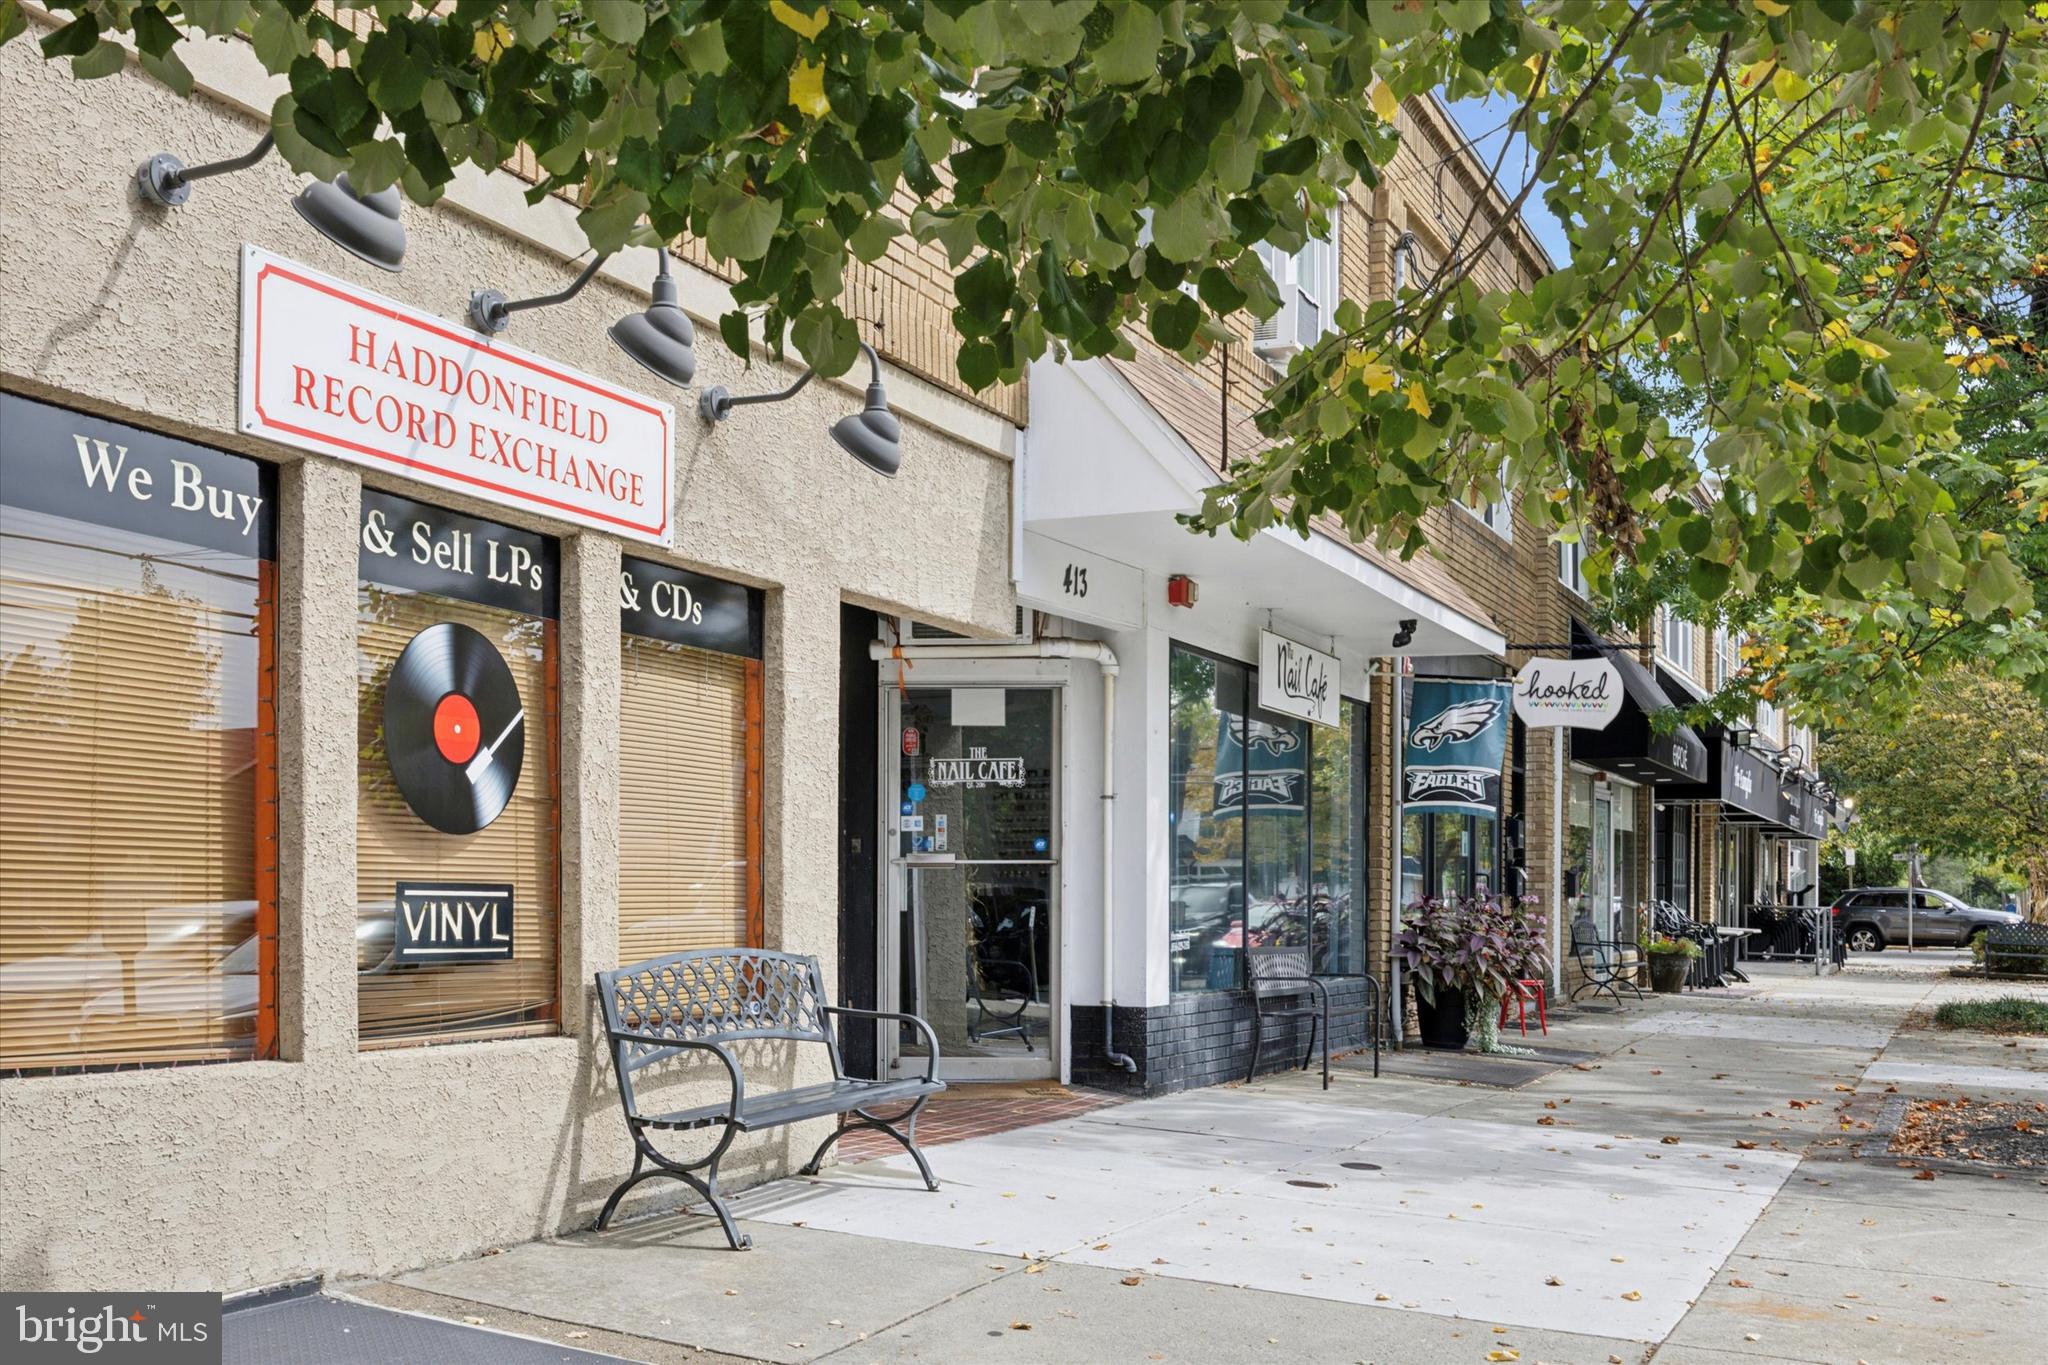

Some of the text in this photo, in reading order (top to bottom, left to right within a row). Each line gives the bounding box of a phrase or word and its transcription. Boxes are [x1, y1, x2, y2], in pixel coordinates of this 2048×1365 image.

[348, 322, 608, 445] HADDONFIELD
[292, 364, 646, 508] RECORD EXCHANGE
[73, 434, 263, 536] We Buy
[363, 509, 542, 590] & Sell LPs
[620, 571, 702, 625] & CDs
[1063, 563, 1088, 598] 413
[1278, 643, 1304, 699] Nail
[1519, 669, 1609, 700] hooked
[937, 761, 1017, 780] NAIL CAFE
[969, 746, 988, 759] THE
[1410, 771, 1485, 798] EAGLES
[402, 901, 510, 942] VINYL
